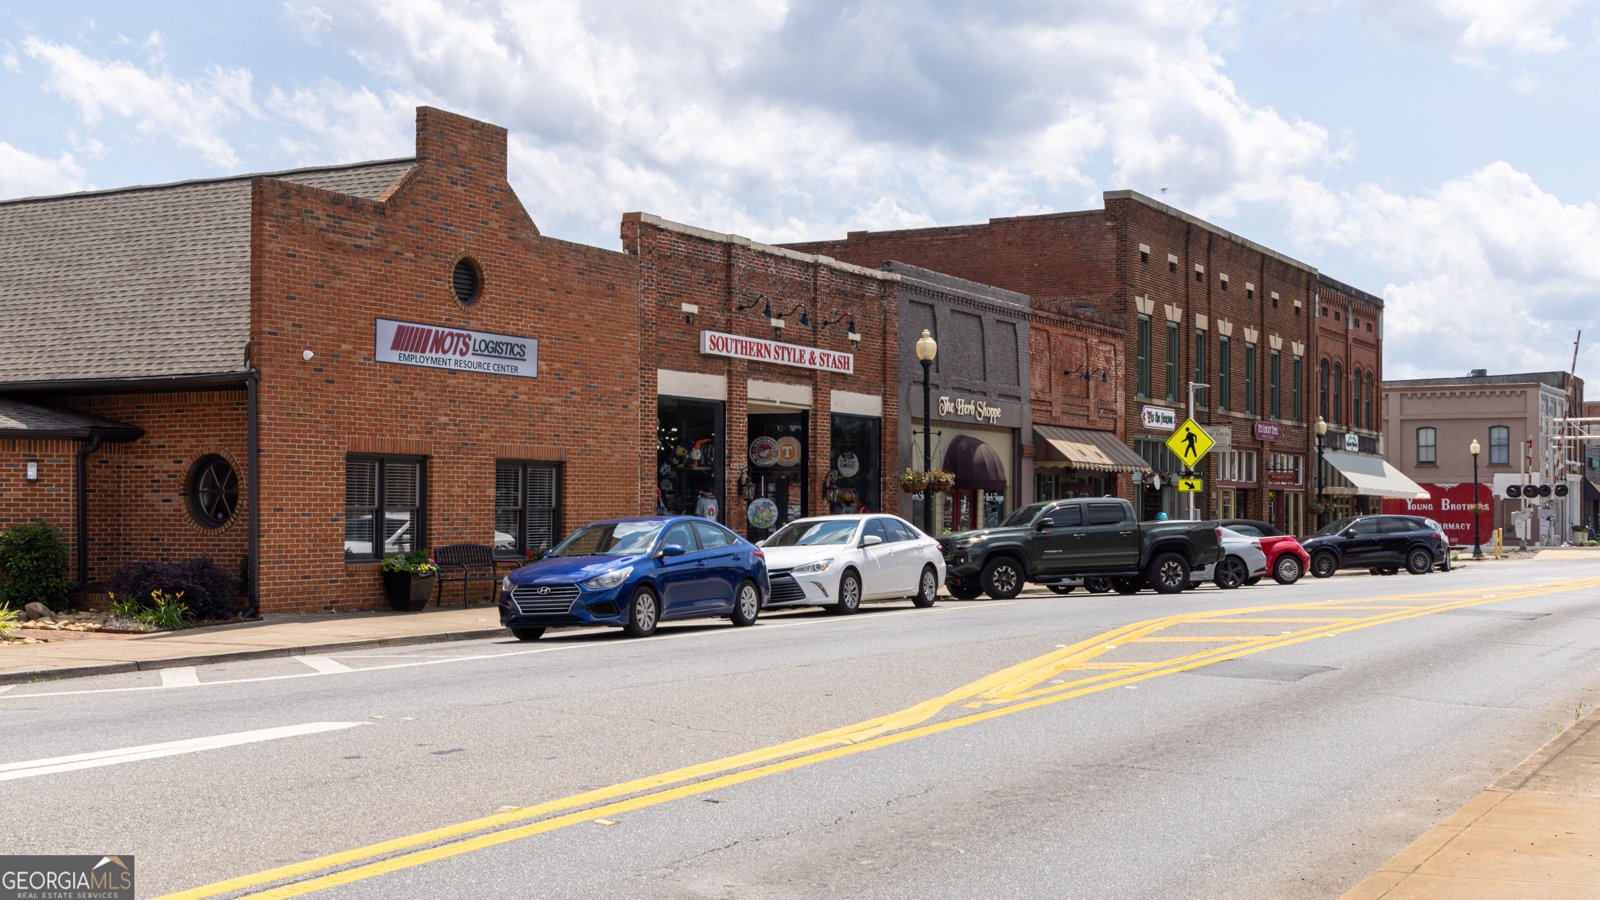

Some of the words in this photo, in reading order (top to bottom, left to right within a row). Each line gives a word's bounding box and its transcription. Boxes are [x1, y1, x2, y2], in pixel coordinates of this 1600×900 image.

[428, 329, 473, 357] NOTS
[472, 338, 526, 358] LOGISTICS
[709, 334, 771, 359] SOUTHERN
[773, 345, 806, 365] STYLE
[809, 351, 817, 366] &
[819, 353, 850, 371] STASH
[398, 353, 452, 367] EMPLOYMENT
[454, 359, 491, 371] RESOURCE
[492, 363, 519, 374] CENTER
[939, 396, 955, 417] The
[956, 398, 975, 416] Herb
[976, 401, 1002, 424] Shoppe
[1406, 498, 1434, 511] YOUNG
[1441, 498, 1490, 511] BROTHS
